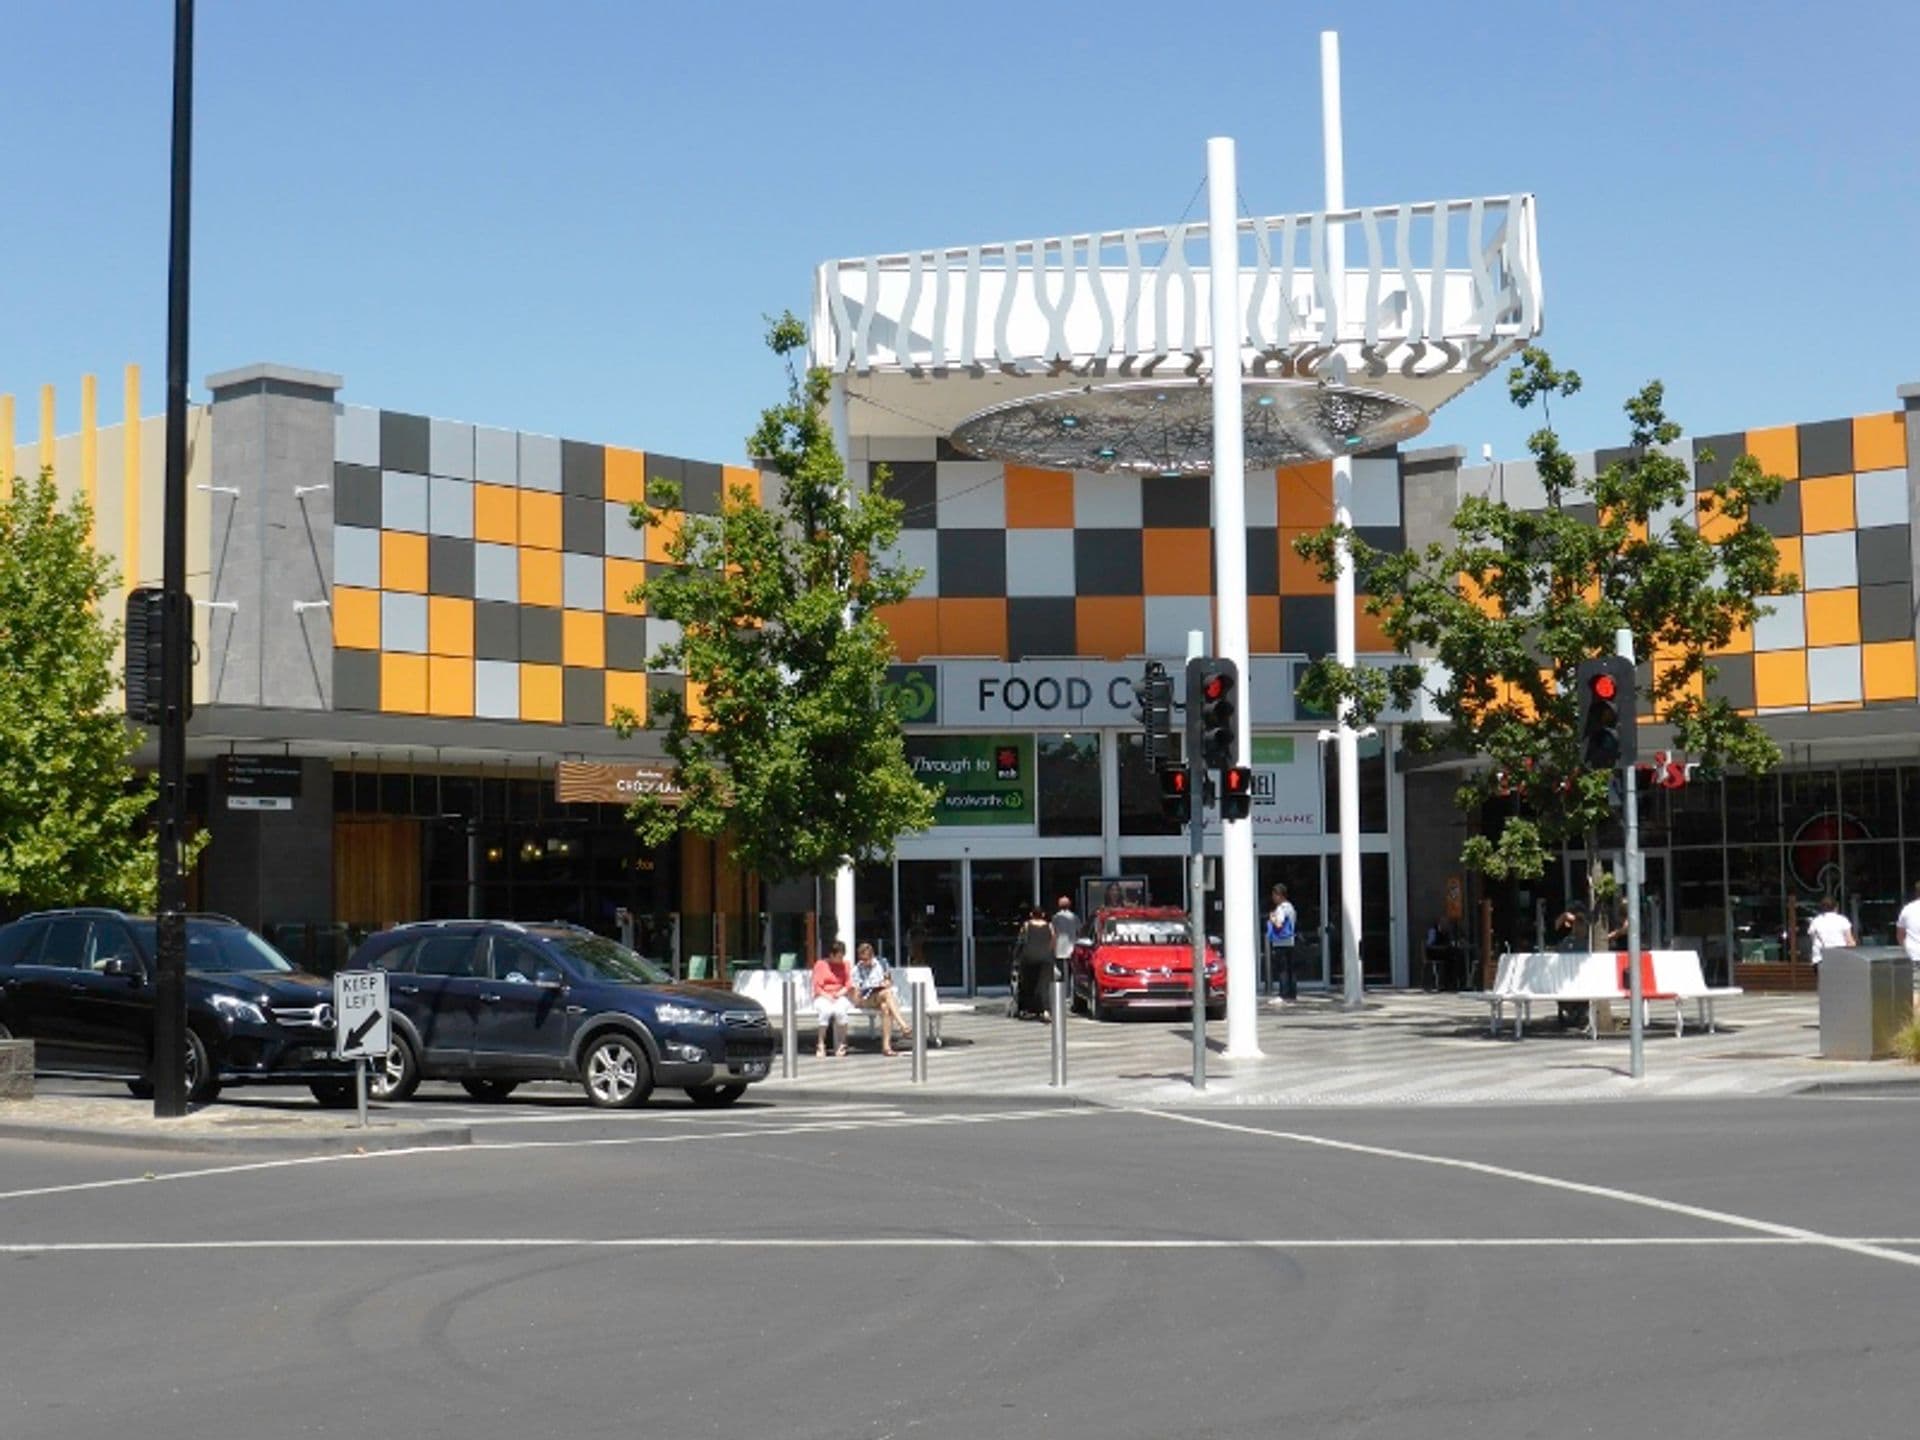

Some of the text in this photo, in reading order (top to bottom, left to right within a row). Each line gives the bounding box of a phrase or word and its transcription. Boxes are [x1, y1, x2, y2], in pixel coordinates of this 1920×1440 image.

[978, 676, 1093, 712] FOOD
[976, 758, 991, 772] to
[343, 976, 377, 992] KEEP
[345, 993, 376, 1009] LEFT
